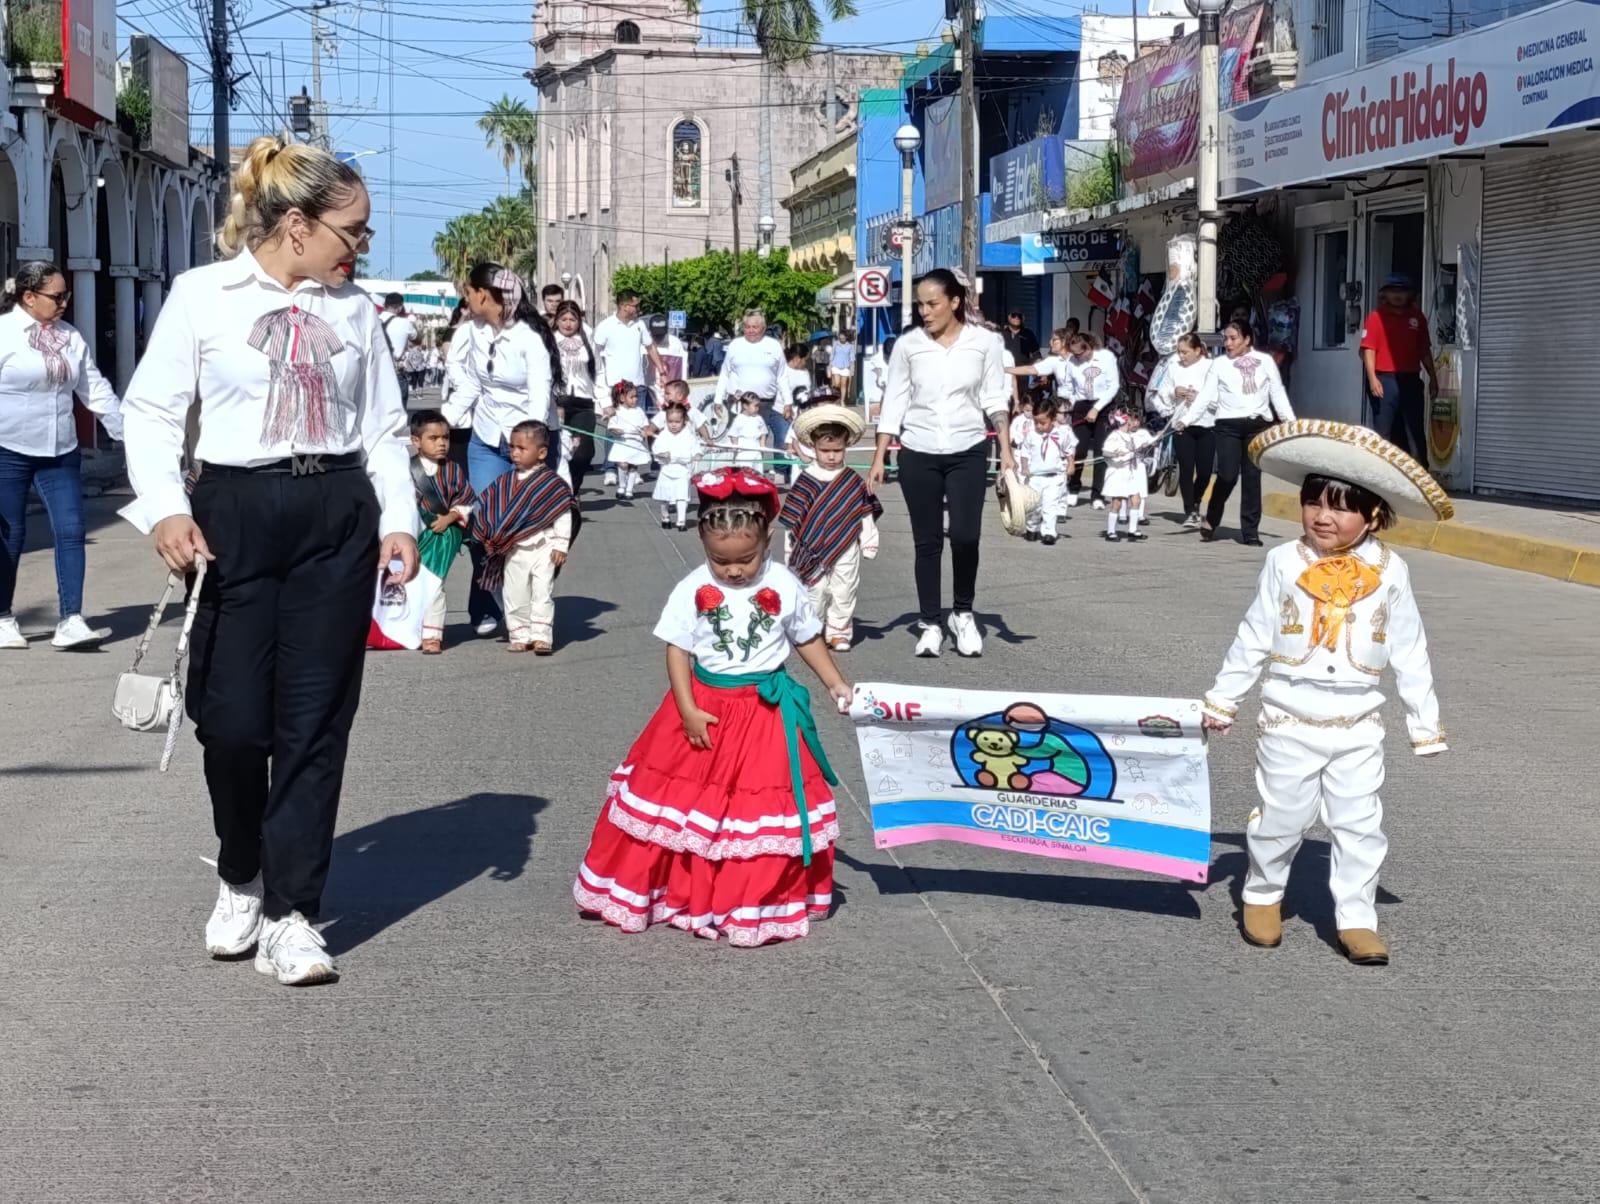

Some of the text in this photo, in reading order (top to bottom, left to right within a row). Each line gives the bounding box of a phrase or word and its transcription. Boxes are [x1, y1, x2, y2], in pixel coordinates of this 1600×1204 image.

[1523, 28, 1587, 59] MEDICINA GENERAL
[1523, 57, 1593, 88] VALORACION MEDICA
[1522, 89, 1548, 106] CONTINUA
[1034, 232, 1108, 248] CENTRO DE
[1054, 248, 1088, 261] PAGO
[879, 701, 922, 721] DIF
[997, 792, 1077, 810] GUARDERIAS
[972, 804, 1110, 843] CADI-CAIC
[1050, 841, 1087, 853] SINALOA
